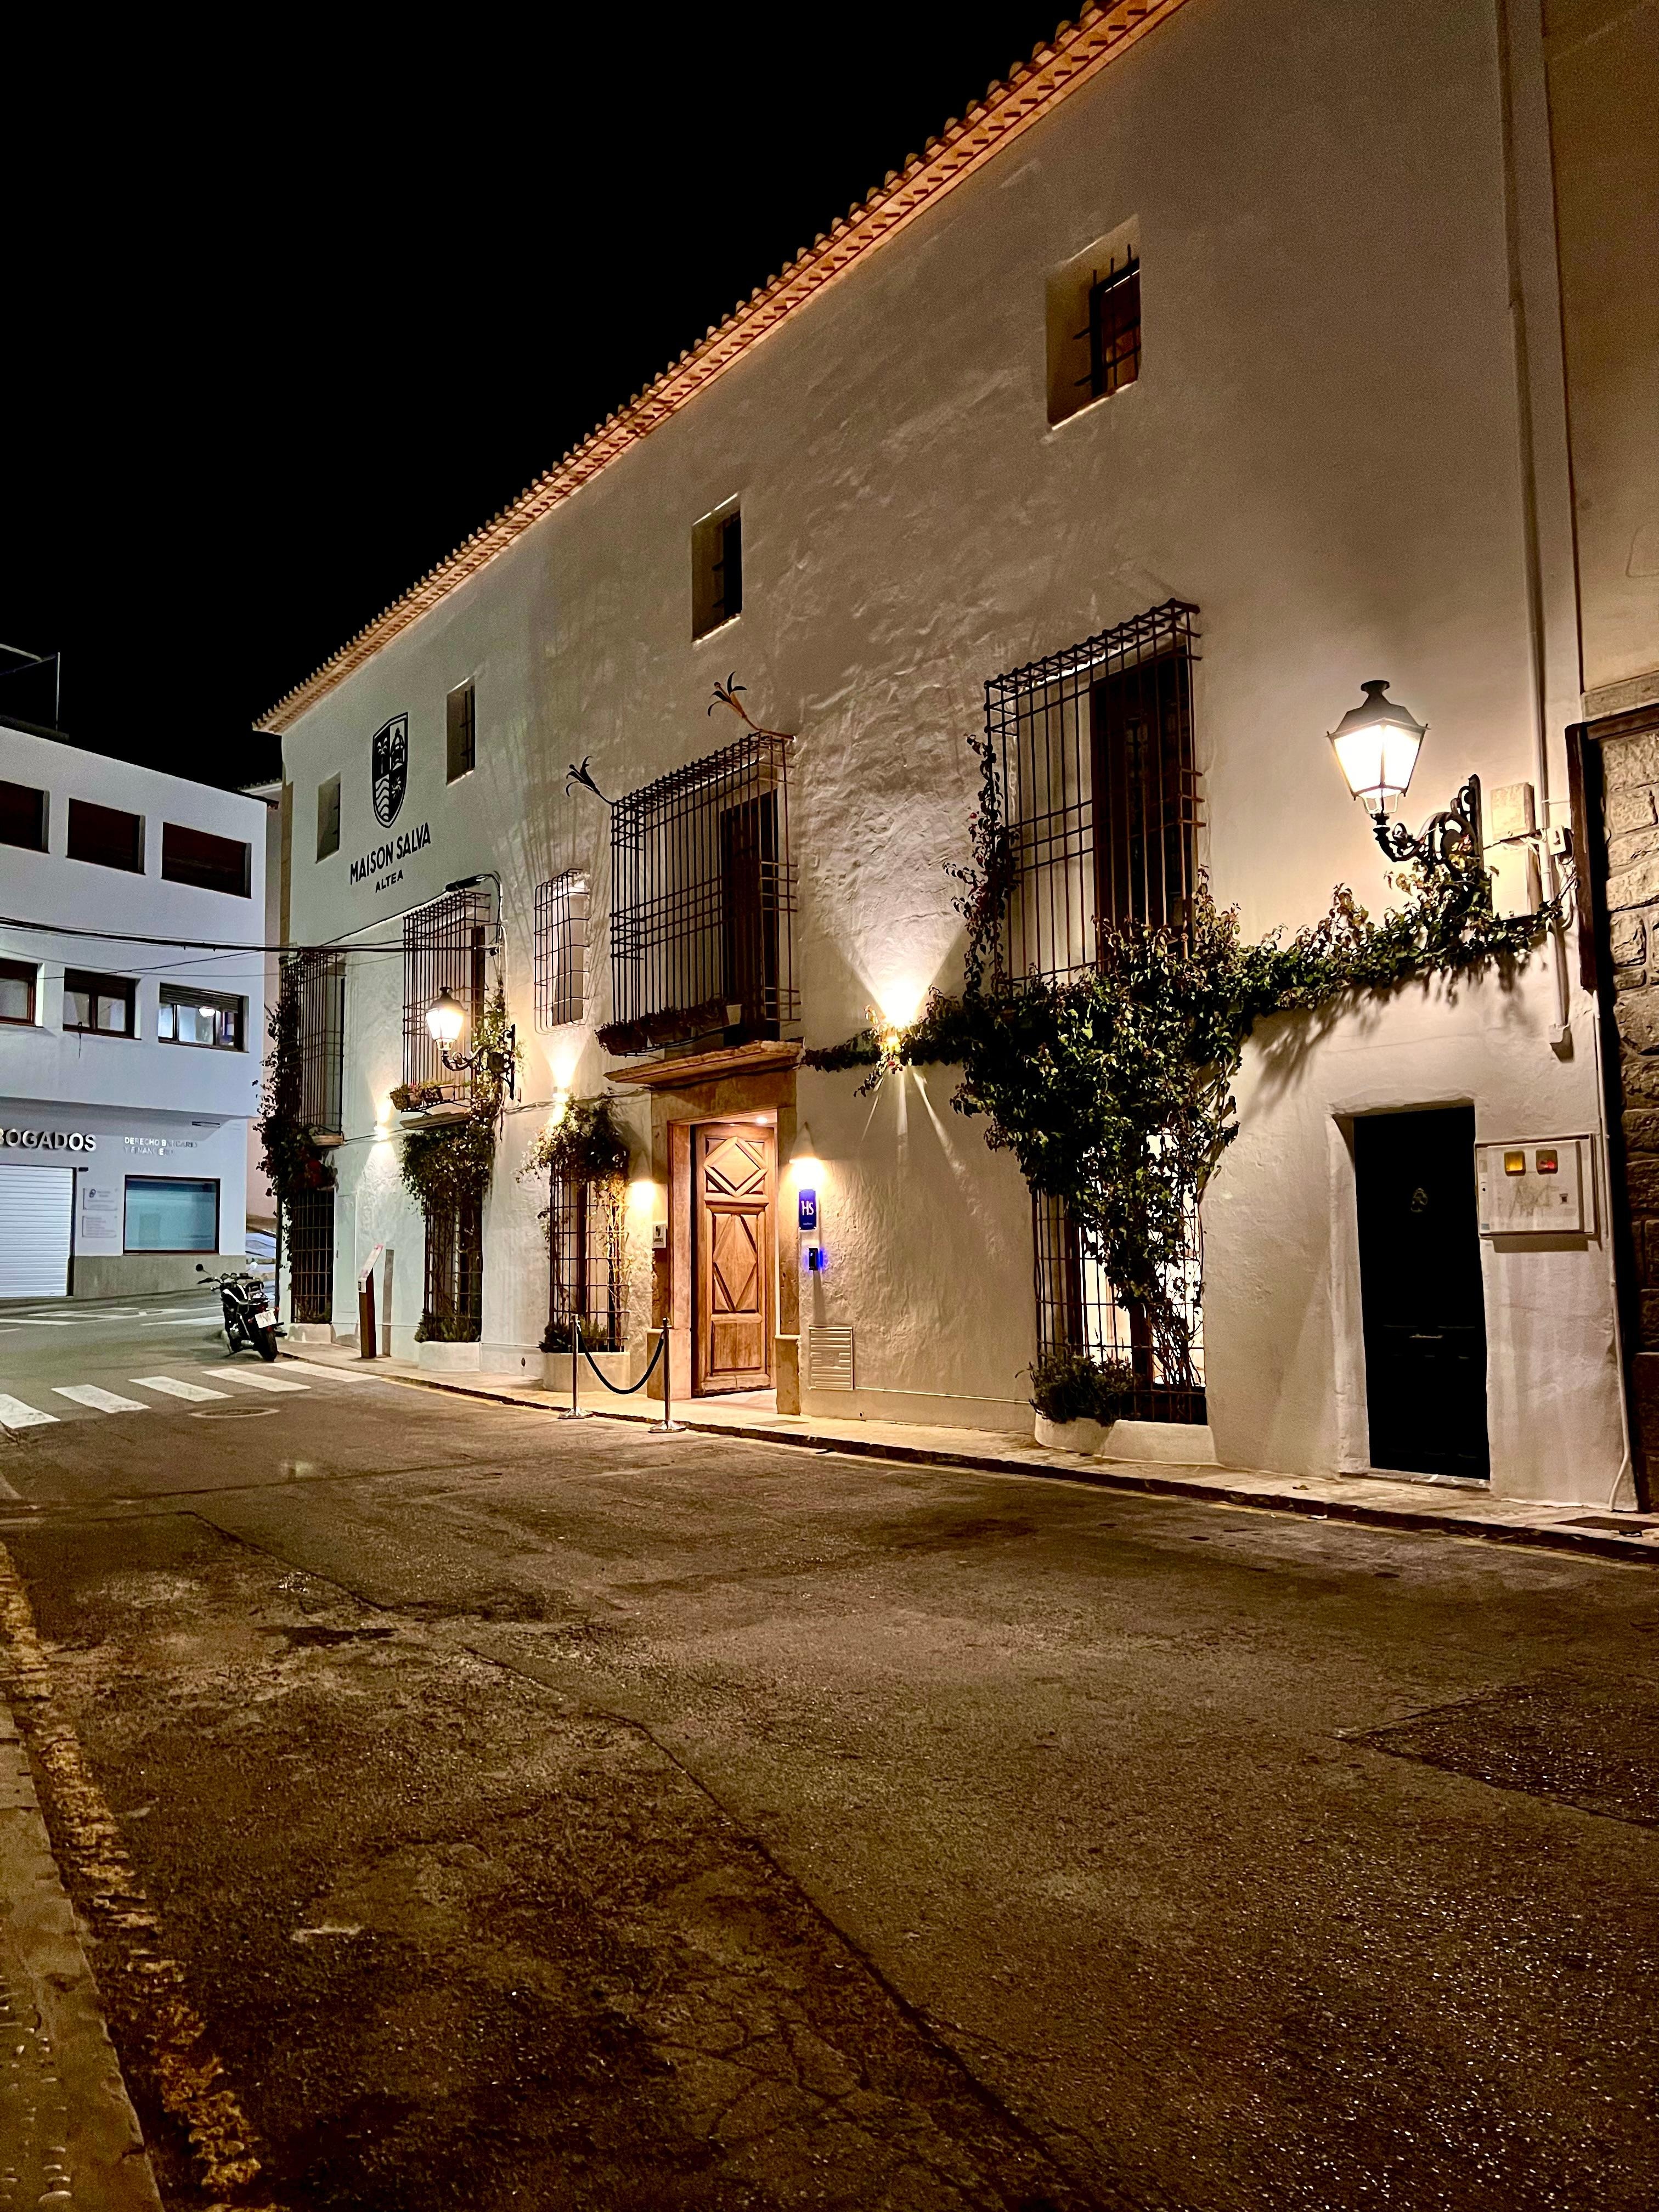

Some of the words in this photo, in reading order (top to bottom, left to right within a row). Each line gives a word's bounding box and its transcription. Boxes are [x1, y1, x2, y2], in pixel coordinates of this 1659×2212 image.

[350, 841, 393, 885] MAISON
[396, 822, 431, 860] SALVA
[375, 869, 404, 893] ALTEA
[124, 1136, 160, 1146] DERECHO
